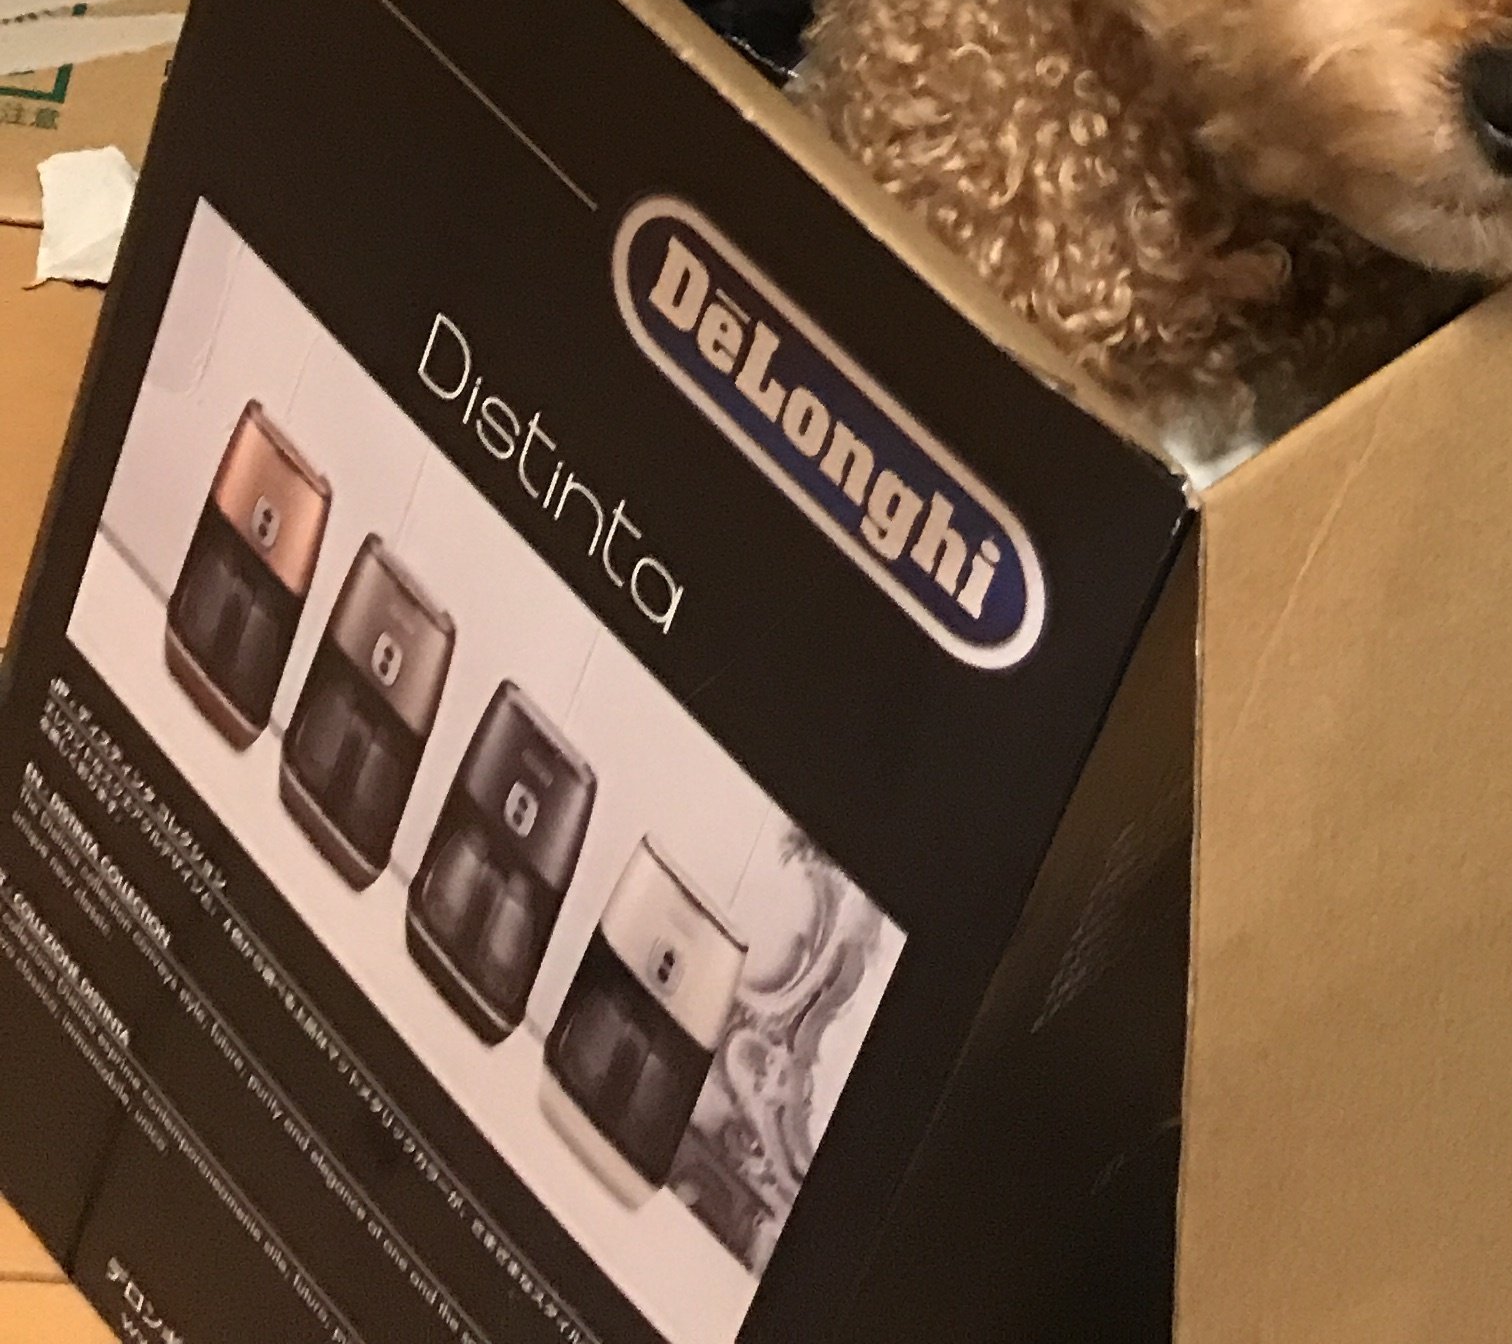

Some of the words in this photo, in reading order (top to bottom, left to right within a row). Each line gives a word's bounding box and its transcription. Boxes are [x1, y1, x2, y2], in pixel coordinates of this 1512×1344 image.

[418, 312, 684, 634] Distinta
[10, 889, 82, 984] COLLEZIONE
[98, 849, 173, 950] COLLECTION
[282, 1109, 311, 1154] and
[307, 1141, 369, 1227] elegance
[408, 1260, 439, 1307] and
[436, 1294, 462, 1335] the
